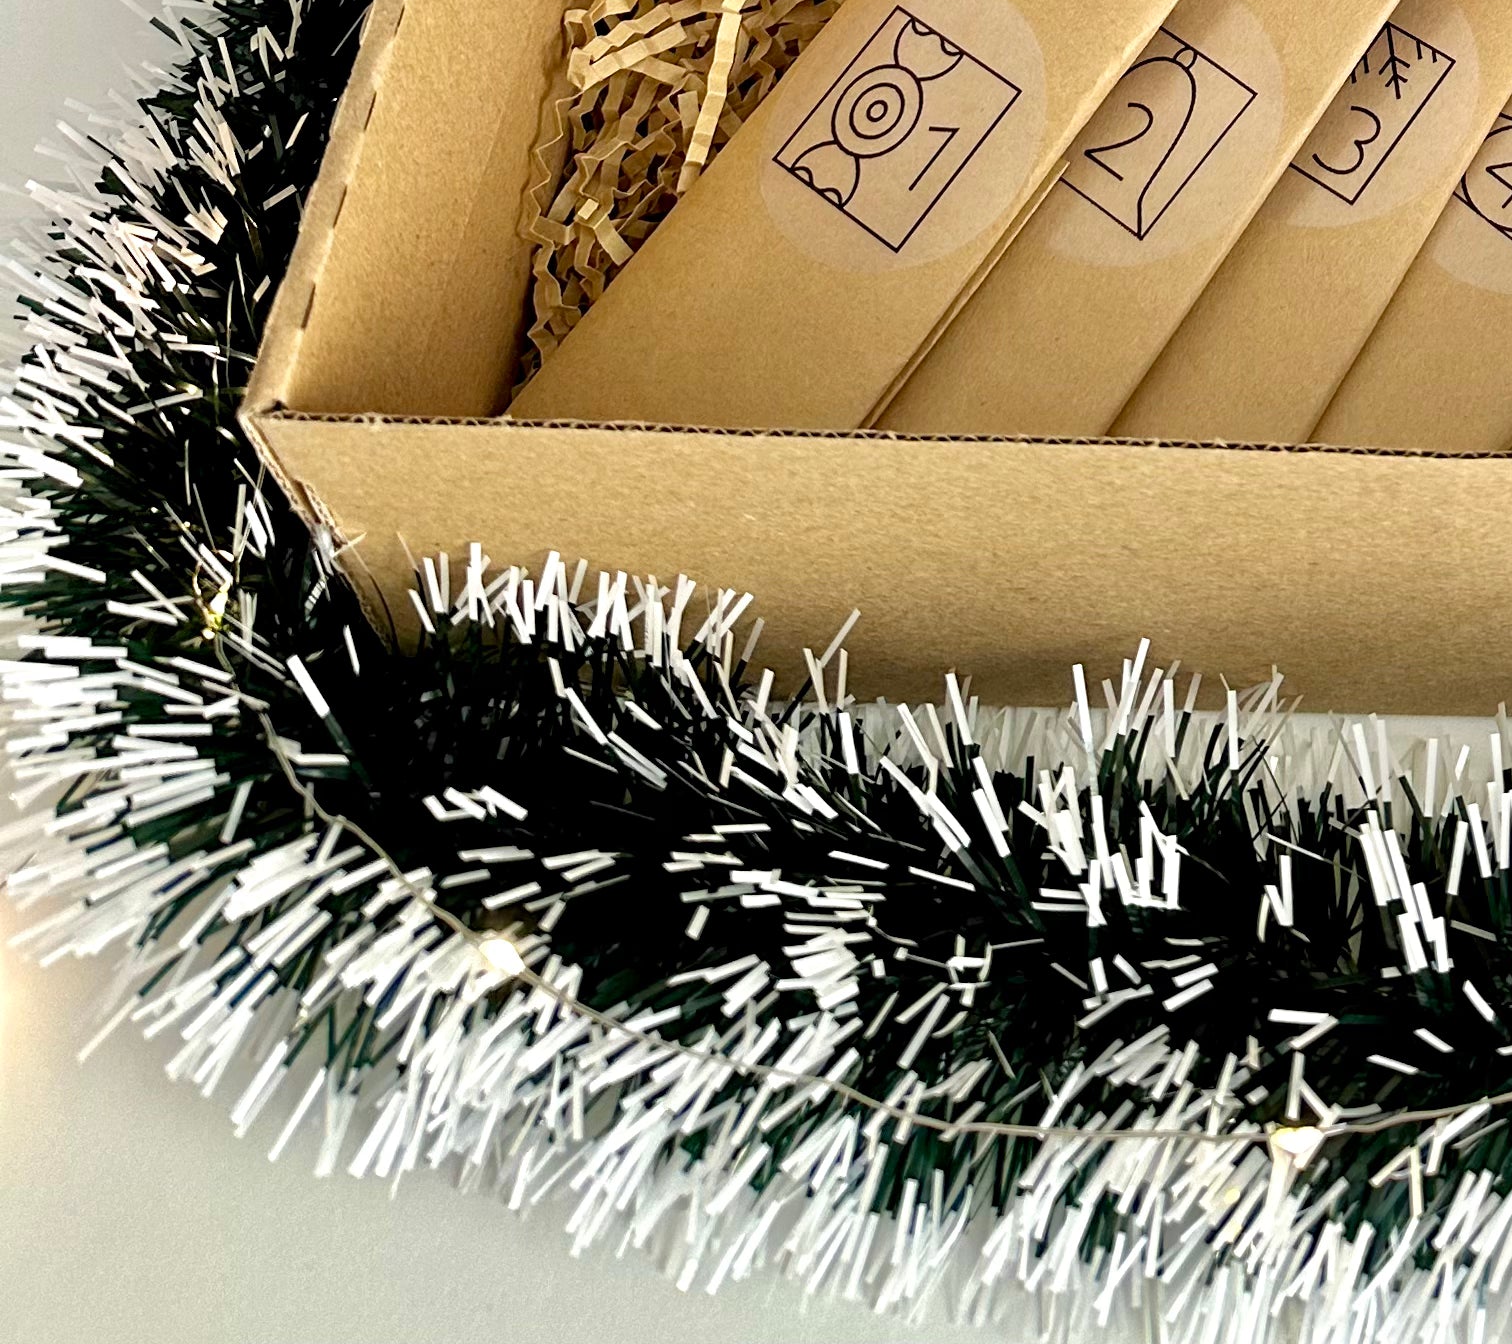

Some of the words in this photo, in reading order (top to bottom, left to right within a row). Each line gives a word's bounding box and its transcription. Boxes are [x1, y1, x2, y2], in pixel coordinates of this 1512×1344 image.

[907, 124, 960, 191] 1
[1083, 101, 1155, 183] 2
[1311, 105, 1382, 176] 3
